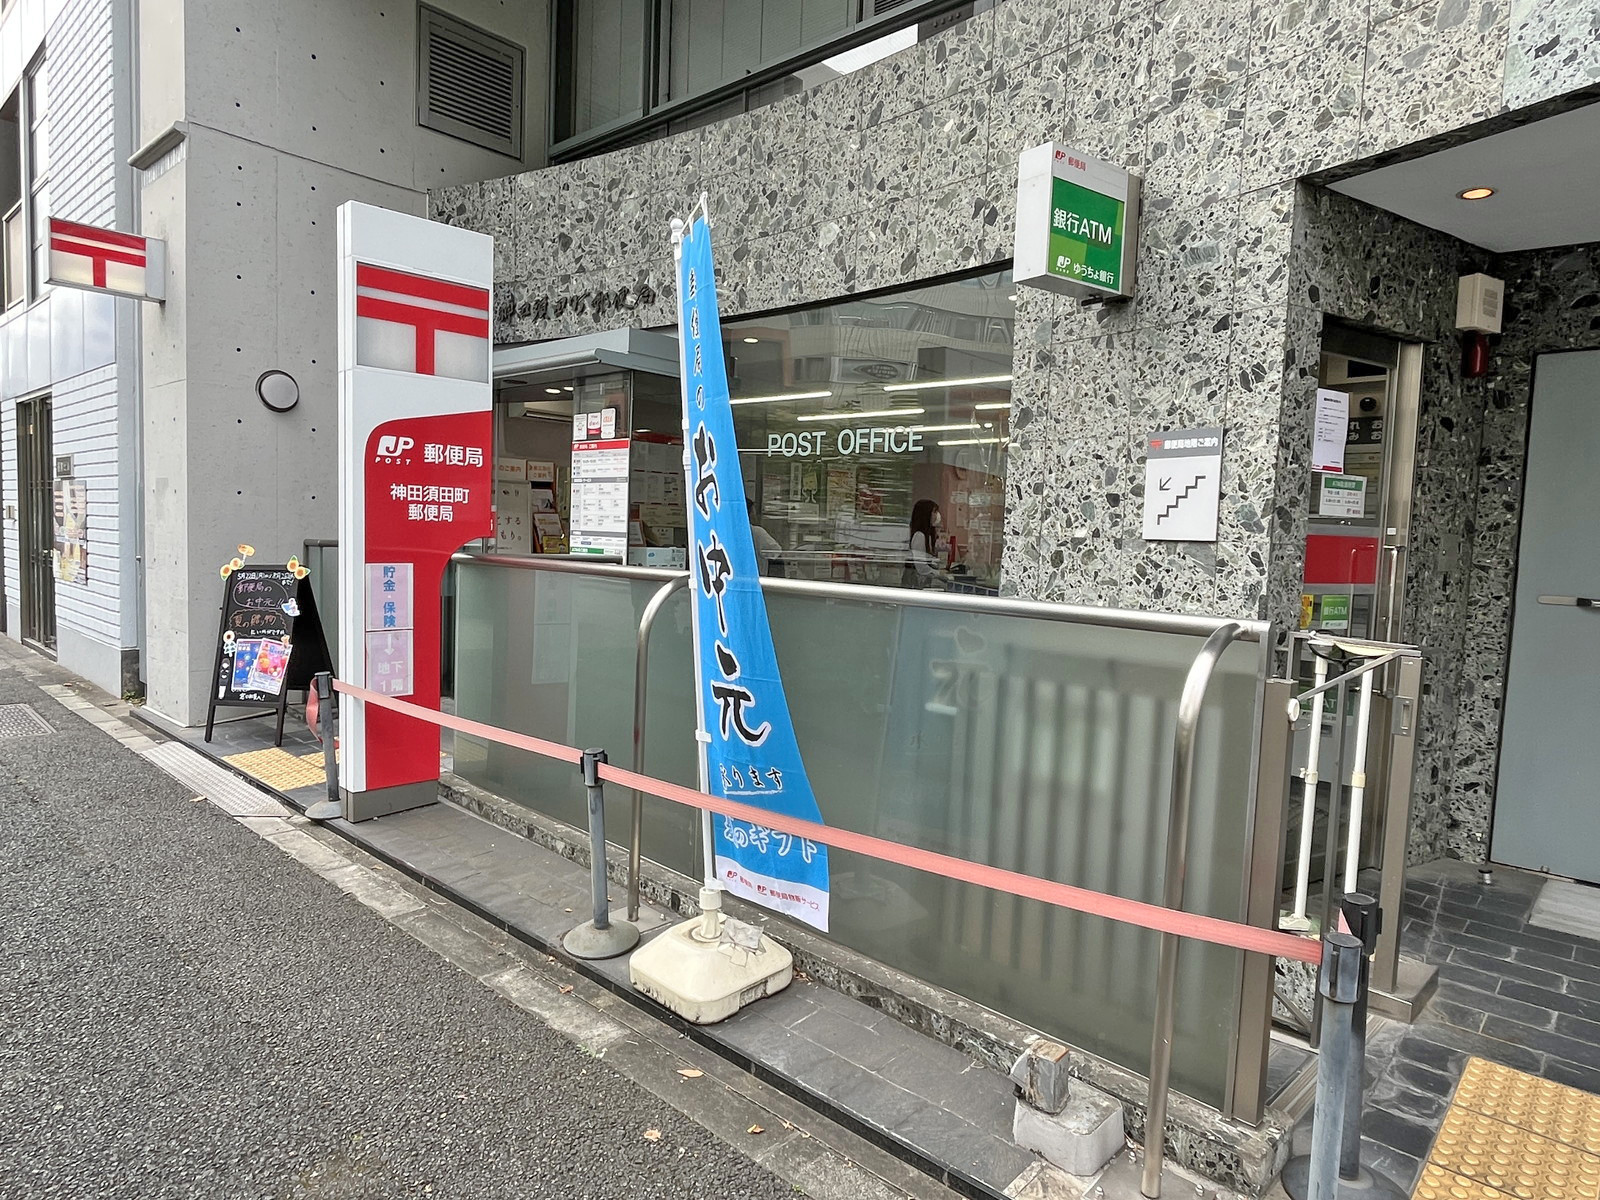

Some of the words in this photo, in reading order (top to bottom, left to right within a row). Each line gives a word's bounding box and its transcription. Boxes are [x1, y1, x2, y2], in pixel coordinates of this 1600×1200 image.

[1068, 156, 1087, 172] 郵便局
[1052, 207, 1113, 245] 銀行ATM
[1073, 262, 1115, 285] ゆうちょ銀行
[767, 431, 827, 457] POST
[837, 425, 924, 455] OFFICE
[374, 456, 412, 466] POST
[423, 443, 484, 467] 郵便局
[389, 483, 470, 504] 神田須田町
[407, 503, 454, 522] 郵便局
[383, 565, 396, 628] 貯金・保険
[378, 660, 405, 675] 地下
